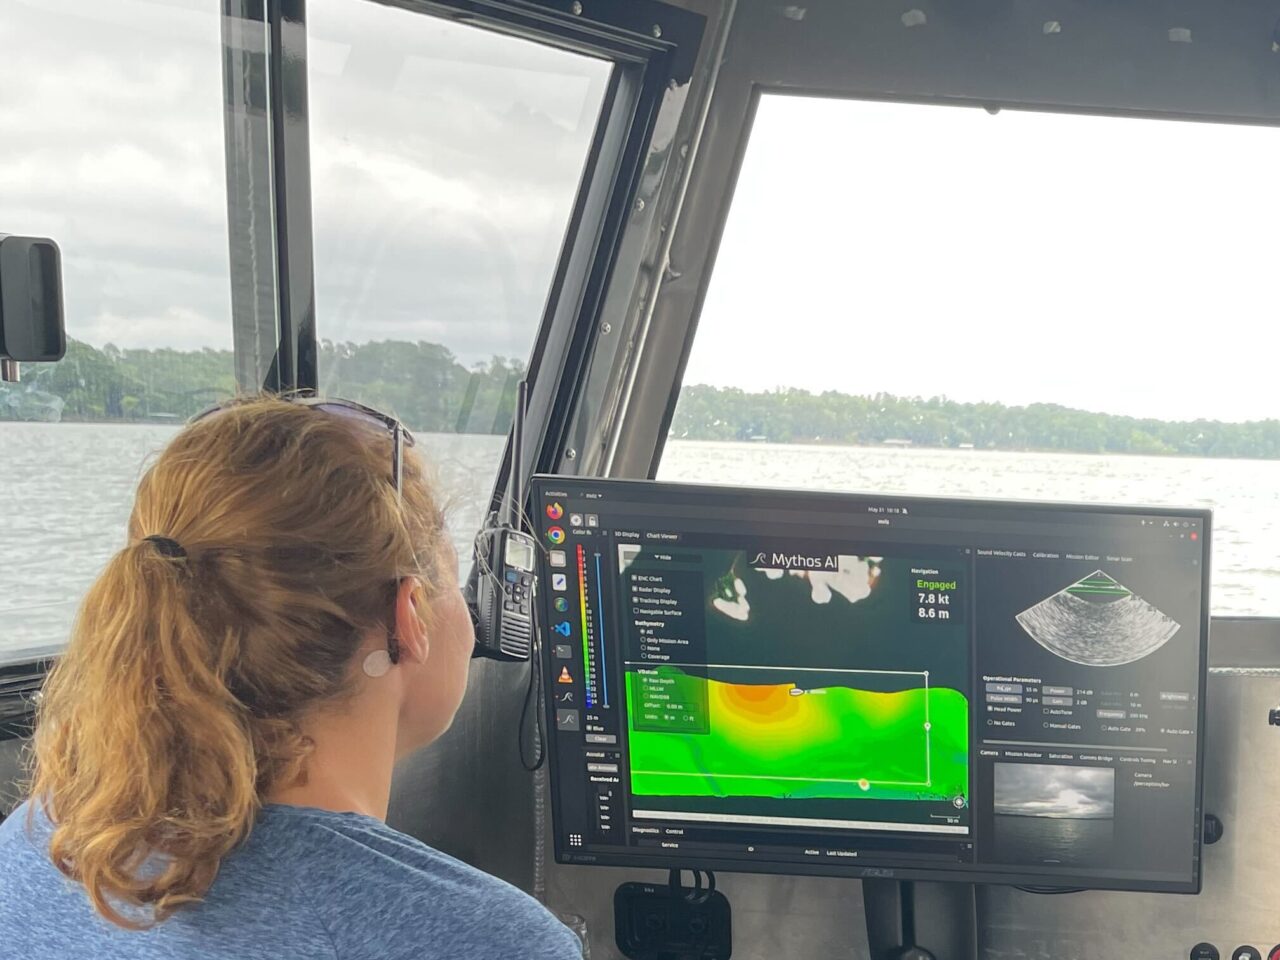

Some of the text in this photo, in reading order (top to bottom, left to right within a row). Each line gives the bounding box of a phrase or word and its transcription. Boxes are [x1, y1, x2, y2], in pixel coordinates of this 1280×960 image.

[977, 549, 992, 557] Sound
[772, 553, 837, 569] Mythos AI
[917, 580, 956, 590] Engaged
[918, 593, 950, 604] 7.8 kt
[918, 608, 950, 619] 8.6 m
